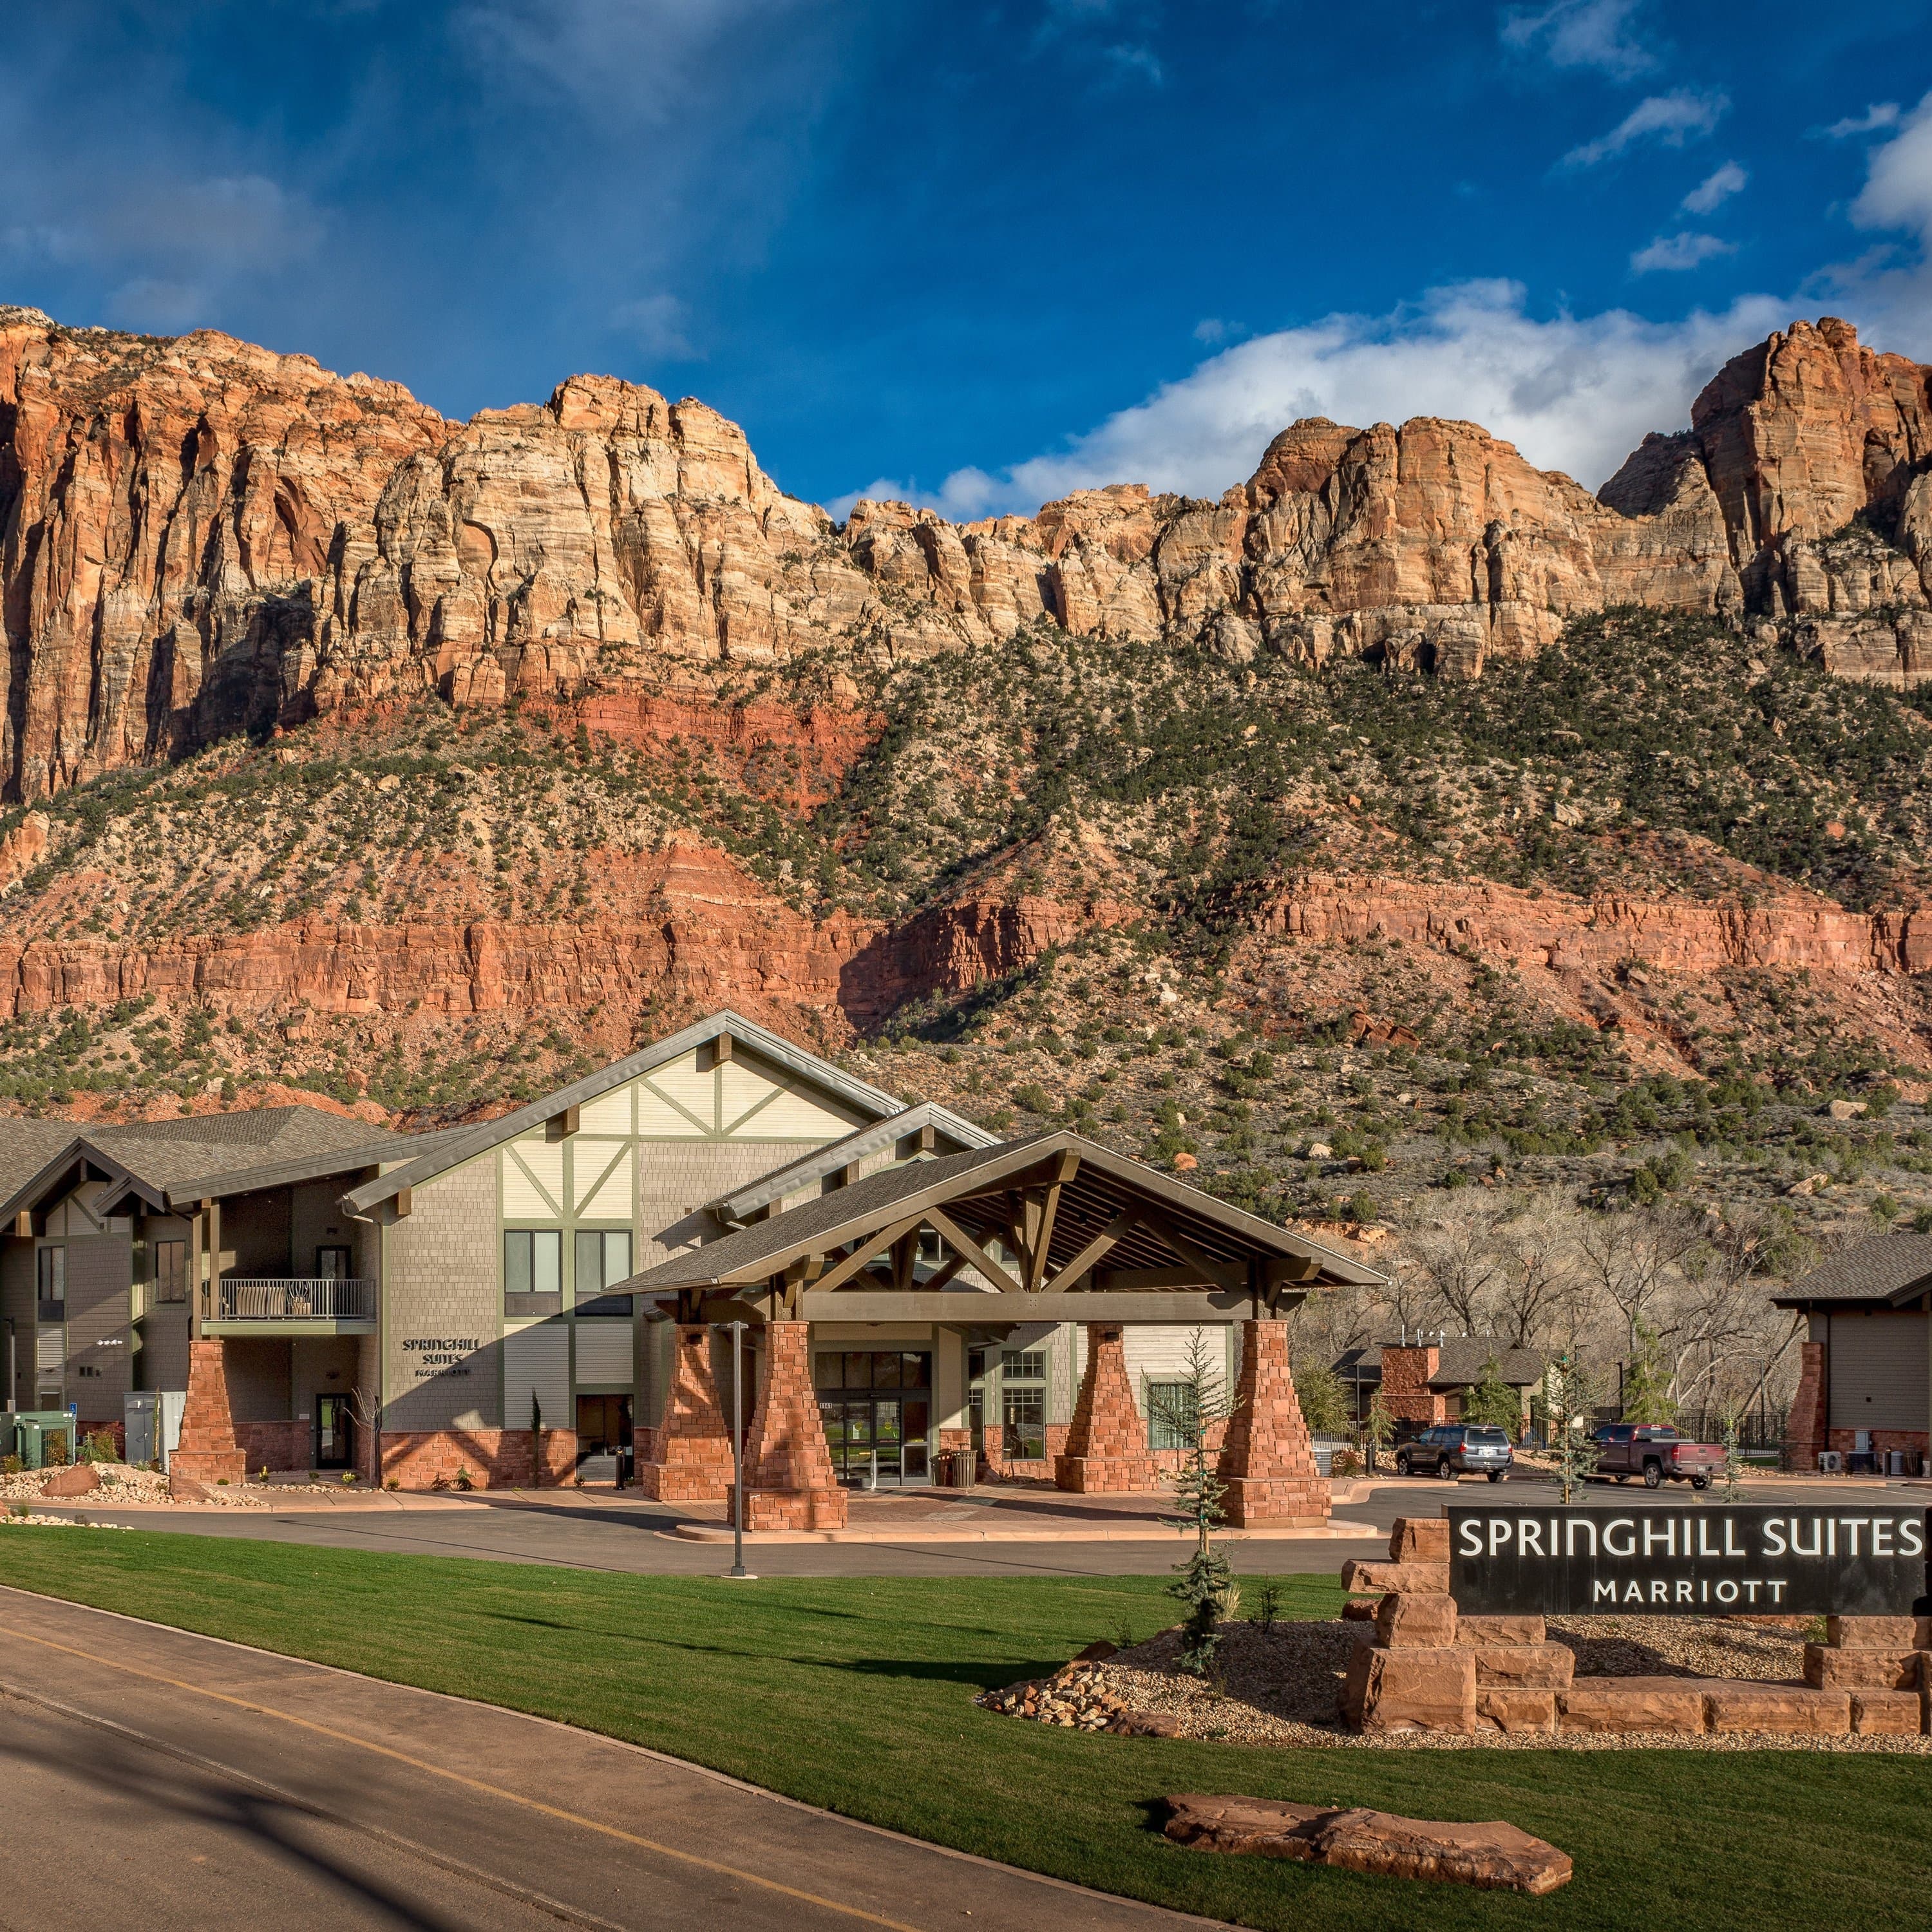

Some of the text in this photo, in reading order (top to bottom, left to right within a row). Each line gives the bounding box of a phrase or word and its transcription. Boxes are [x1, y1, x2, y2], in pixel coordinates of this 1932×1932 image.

[402, 1338, 480, 1350] SPRINGHILL
[422, 1353, 464, 1364] SUITES
[1459, 1519, 1923, 1557] SPRINGHILL SUITES
[1593, 1580, 1788, 1603] MARRIOTT
